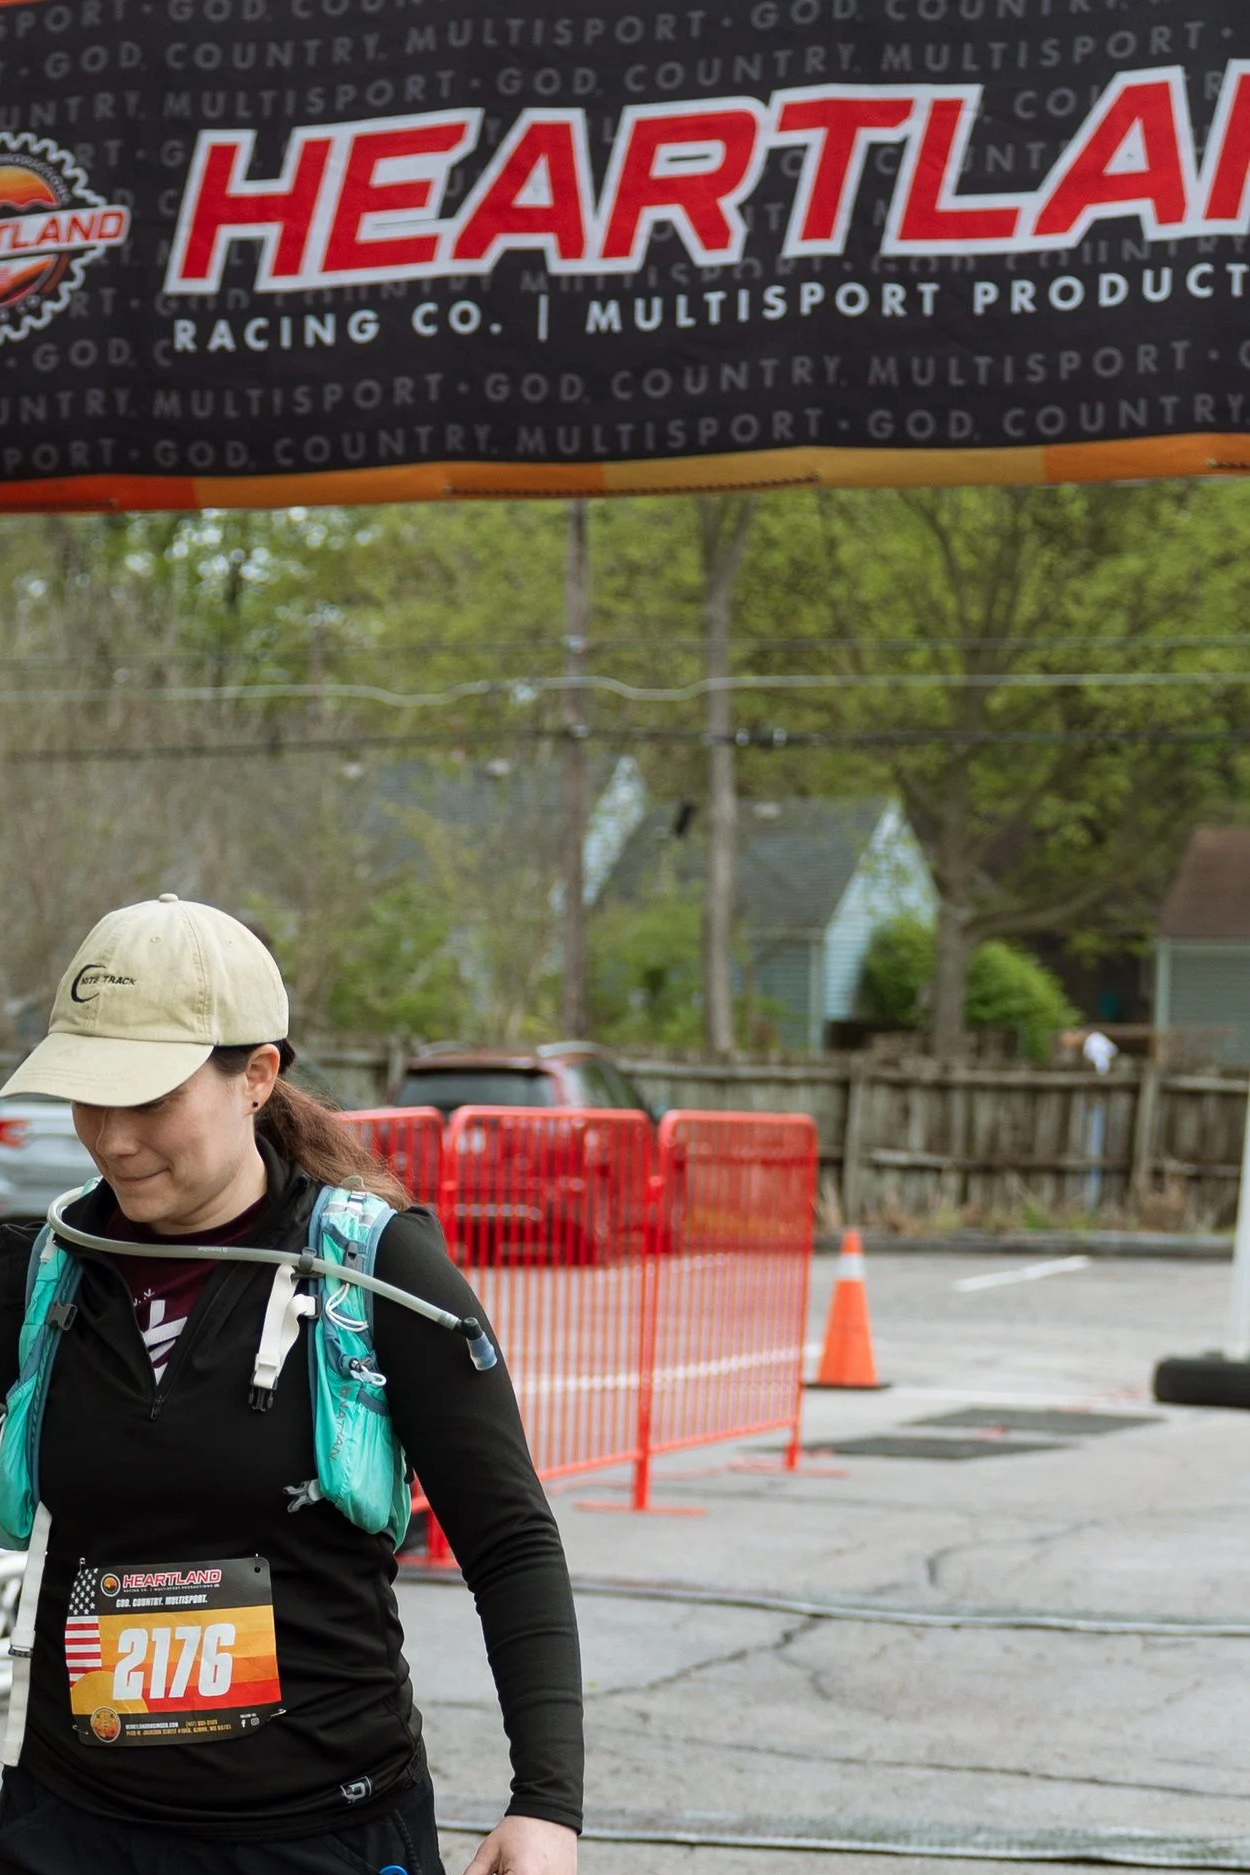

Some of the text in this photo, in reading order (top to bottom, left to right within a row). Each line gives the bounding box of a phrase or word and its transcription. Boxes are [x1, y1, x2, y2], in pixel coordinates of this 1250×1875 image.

[44, 41, 148, 80] GOD.
[164, 32, 388, 70] COUNTRY.
[405, 10, 707, 56] MULTISPORT
[162, 69, 456, 120] MULTISPORT
[496, 66, 604, 97] GOD.
[623, 43, 862, 94] COUNTRY.
[880, 20, 1206, 73] MULTISPORT
[174, 308, 381, 352] RACING
[411, 300, 503, 338] CO.
[584, 281, 941, 335] MULTISPORT
[972, 261, 1250, 317] PRODUCT
[32, 336, 136, 371] GOD.
[153, 372, 444, 420] MULTISPORT
[483, 371, 592, 404] GOD.
[611, 354, 848, 400] COUNTRY.
[867, 340, 1191, 388] MULTISPORT
[273, 424, 498, 467] COUNTRY.
[516, 407, 823, 456] MULTISPORT
[866, 408, 981, 441] GOD.
[102, 975, 137, 986] TRACK
[122, 1568, 222, 1589] HEARTLAND
[112, 1622, 236, 1701] 2176
